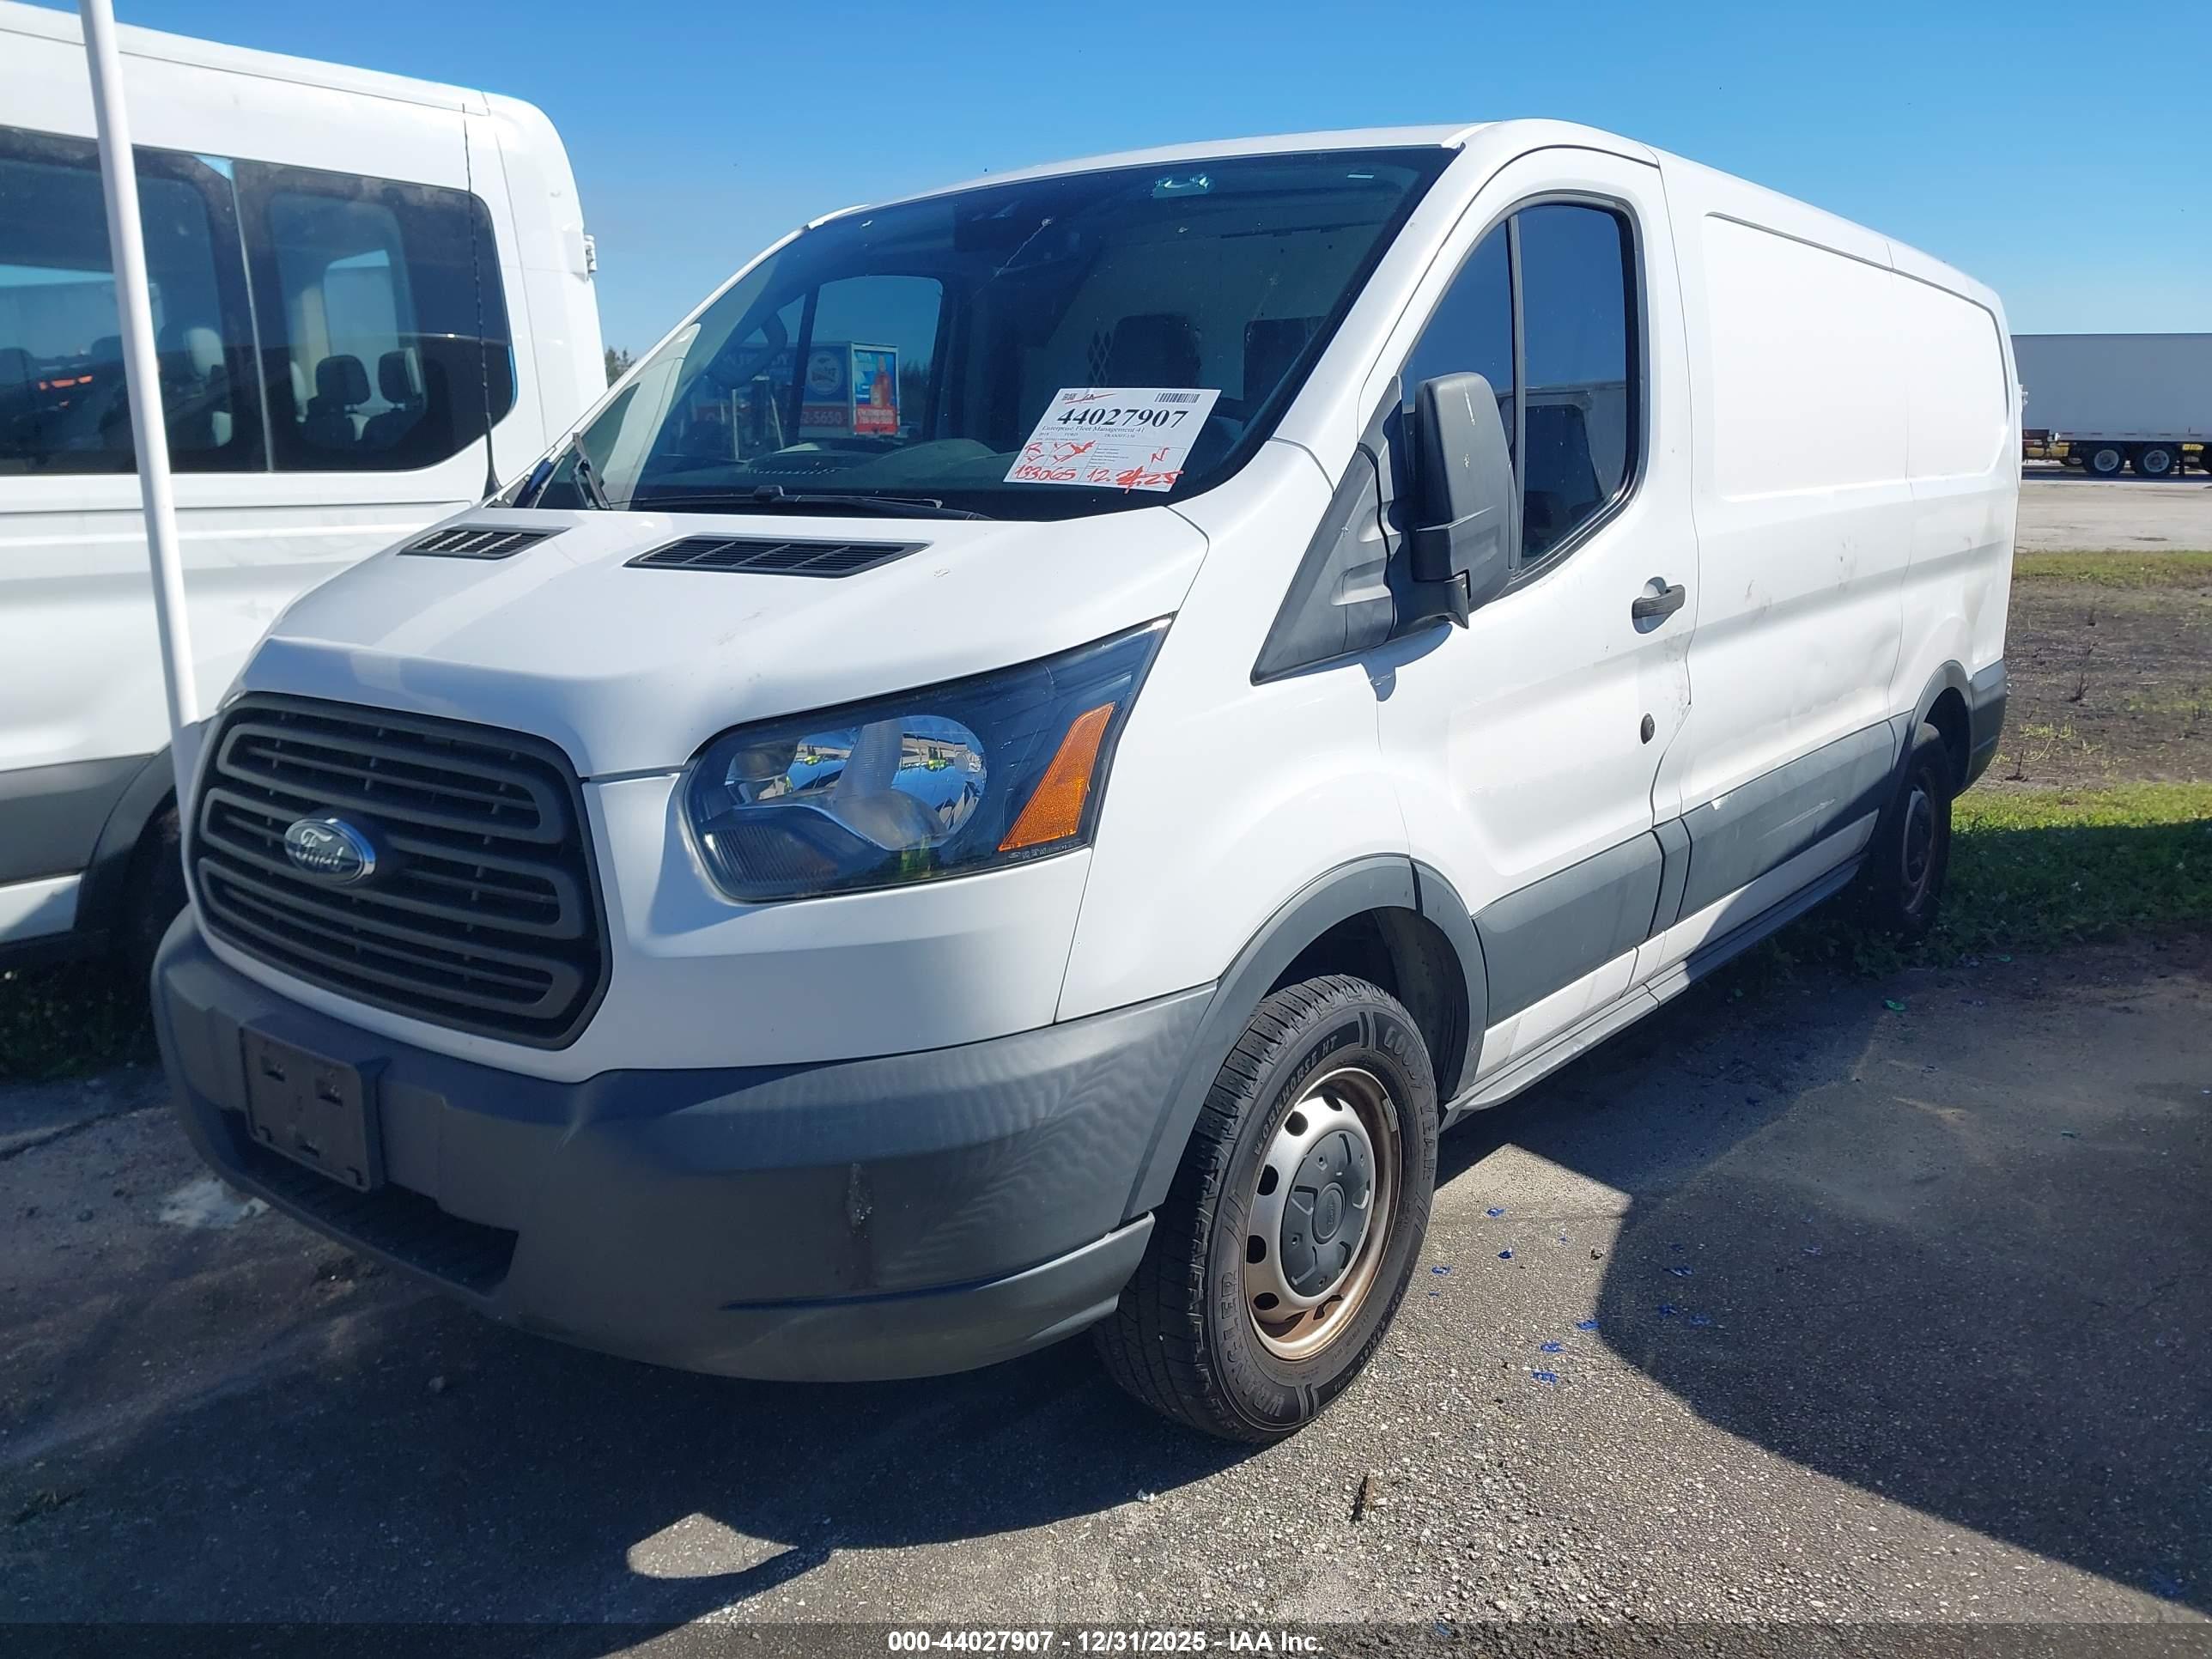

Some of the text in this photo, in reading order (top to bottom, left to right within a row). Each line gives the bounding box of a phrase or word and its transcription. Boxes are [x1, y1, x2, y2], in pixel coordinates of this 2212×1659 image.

[1057, 408, 1188, 428] 44027907
[295, 828, 344, 872] Ford
[1255, 1035, 1339, 1155] WORKHORSE HT
[1221, 1271, 1285, 1418] WRANGLER
